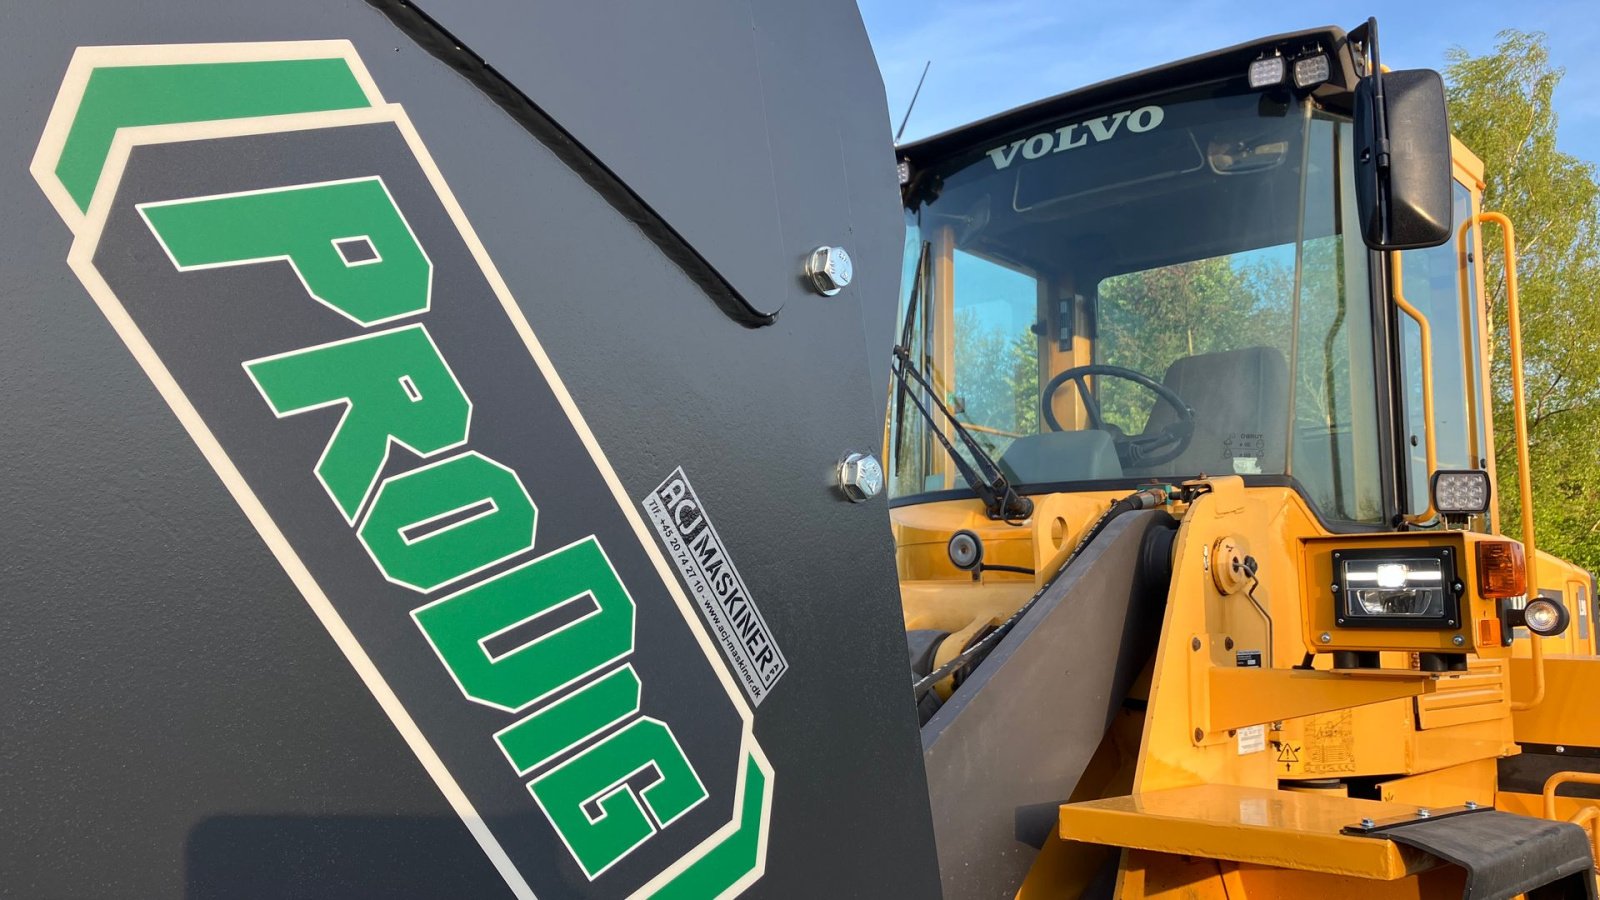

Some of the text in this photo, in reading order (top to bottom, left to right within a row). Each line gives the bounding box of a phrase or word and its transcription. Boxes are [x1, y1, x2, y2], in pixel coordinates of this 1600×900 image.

[985, 105, 1165, 170] VOLVO
[135, 174, 710, 882] PRODIG
[648, 499, 662, 518] Tlf.
[660, 519, 674, 538] +45
[670, 537, 681, 552] 20
[678, 551, 689, 566] 74
[685, 565, 697, 578] 27
[694, 580, 704, 593] 10
[704, 600, 761, 698] www.acj-maskiner.dk
[660, 479, 703, 535] ACJ
[693, 533, 774, 674] MASKINER
